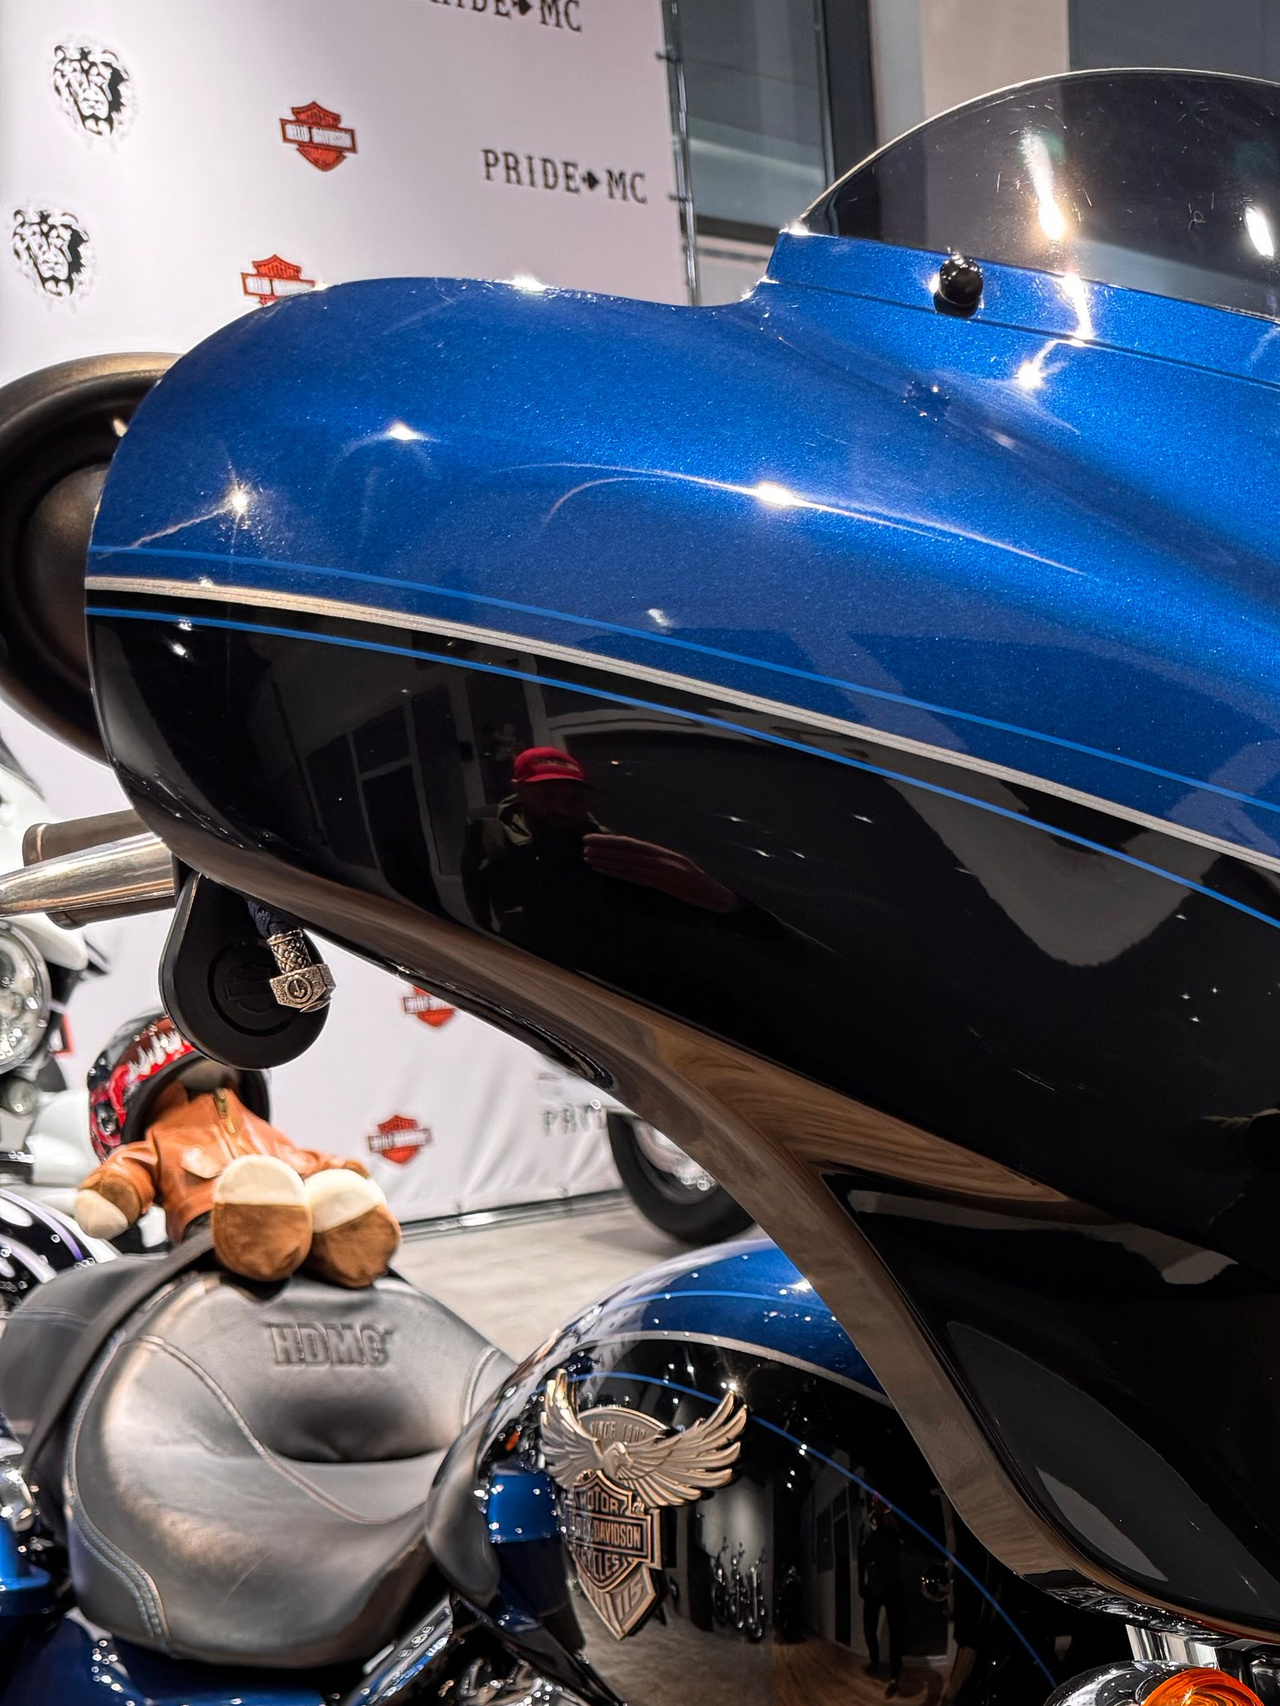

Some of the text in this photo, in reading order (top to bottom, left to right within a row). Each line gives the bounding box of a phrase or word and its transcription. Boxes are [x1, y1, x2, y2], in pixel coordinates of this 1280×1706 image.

[481, 148, 648, 205] PRIDE MC
[593, 1519, 641, 1549] DAVIDSON
